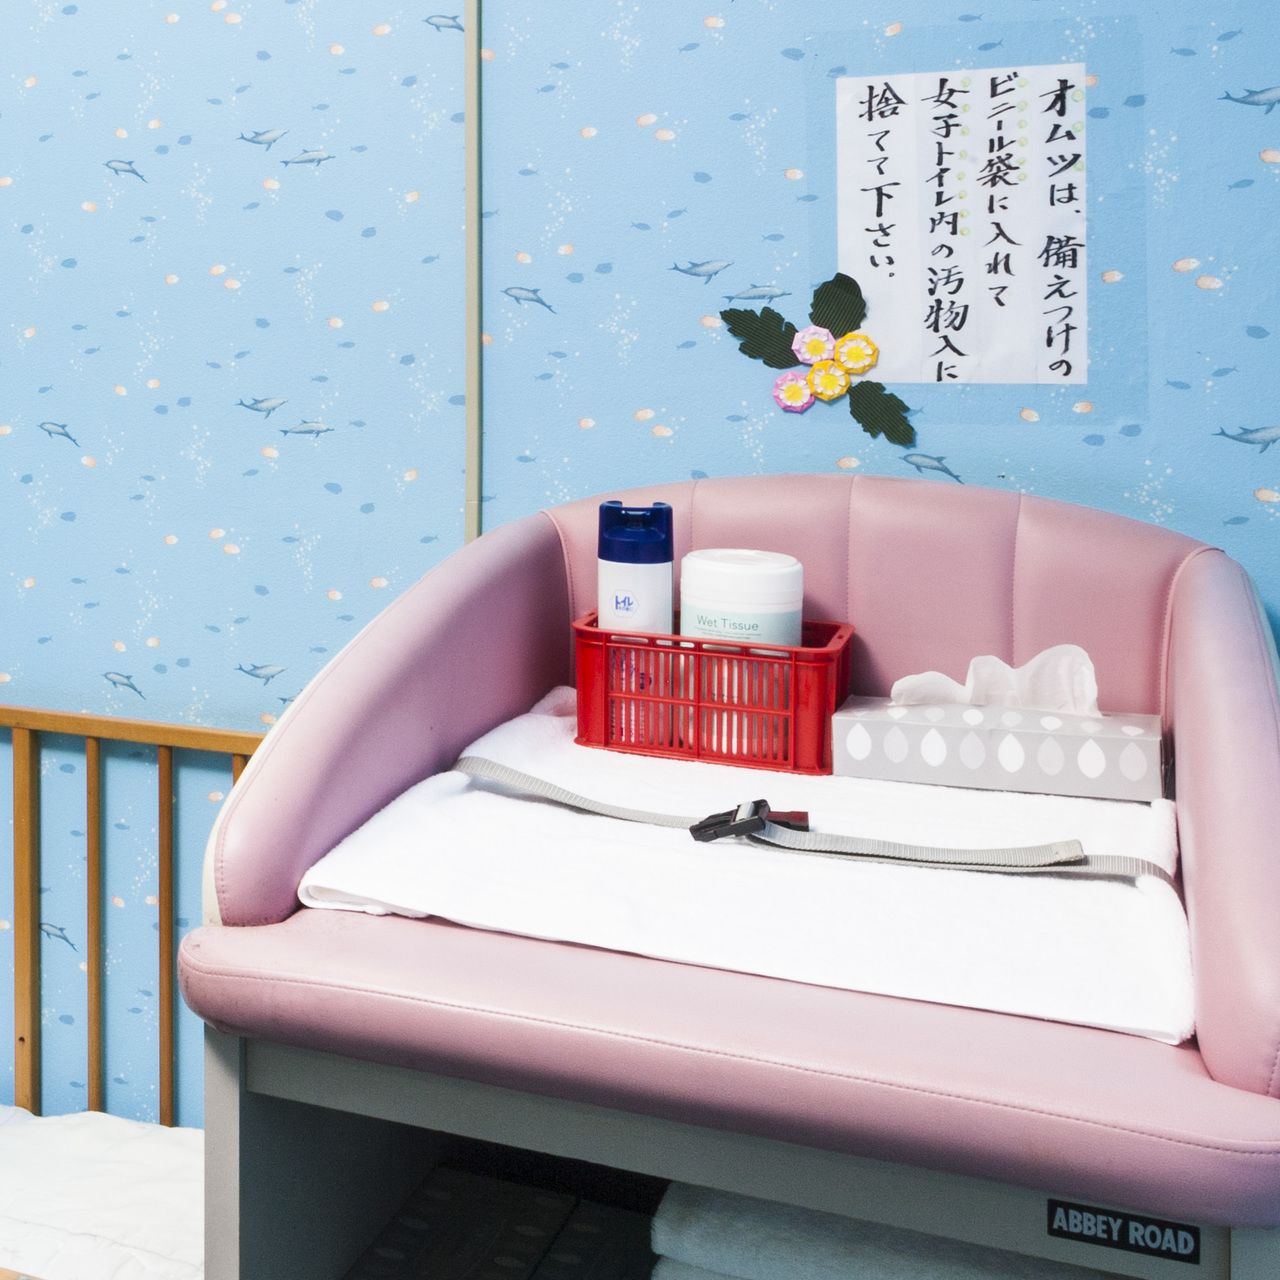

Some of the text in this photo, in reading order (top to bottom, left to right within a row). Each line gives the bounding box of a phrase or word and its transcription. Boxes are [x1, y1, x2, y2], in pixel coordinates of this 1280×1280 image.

[859, 81, 907, 279] 捨てて下さい。
[921, 77, 970, 382] 女子トイレ内の汚物入に
[976, 71, 1022, 307] ビニール袋に入れて
[1038, 78, 1085, 378] オムツは、備えつけの
[696, 614, 759, 632] Wet Tissue
[1052, 1206, 1195, 1255] ABBEY ROAD
